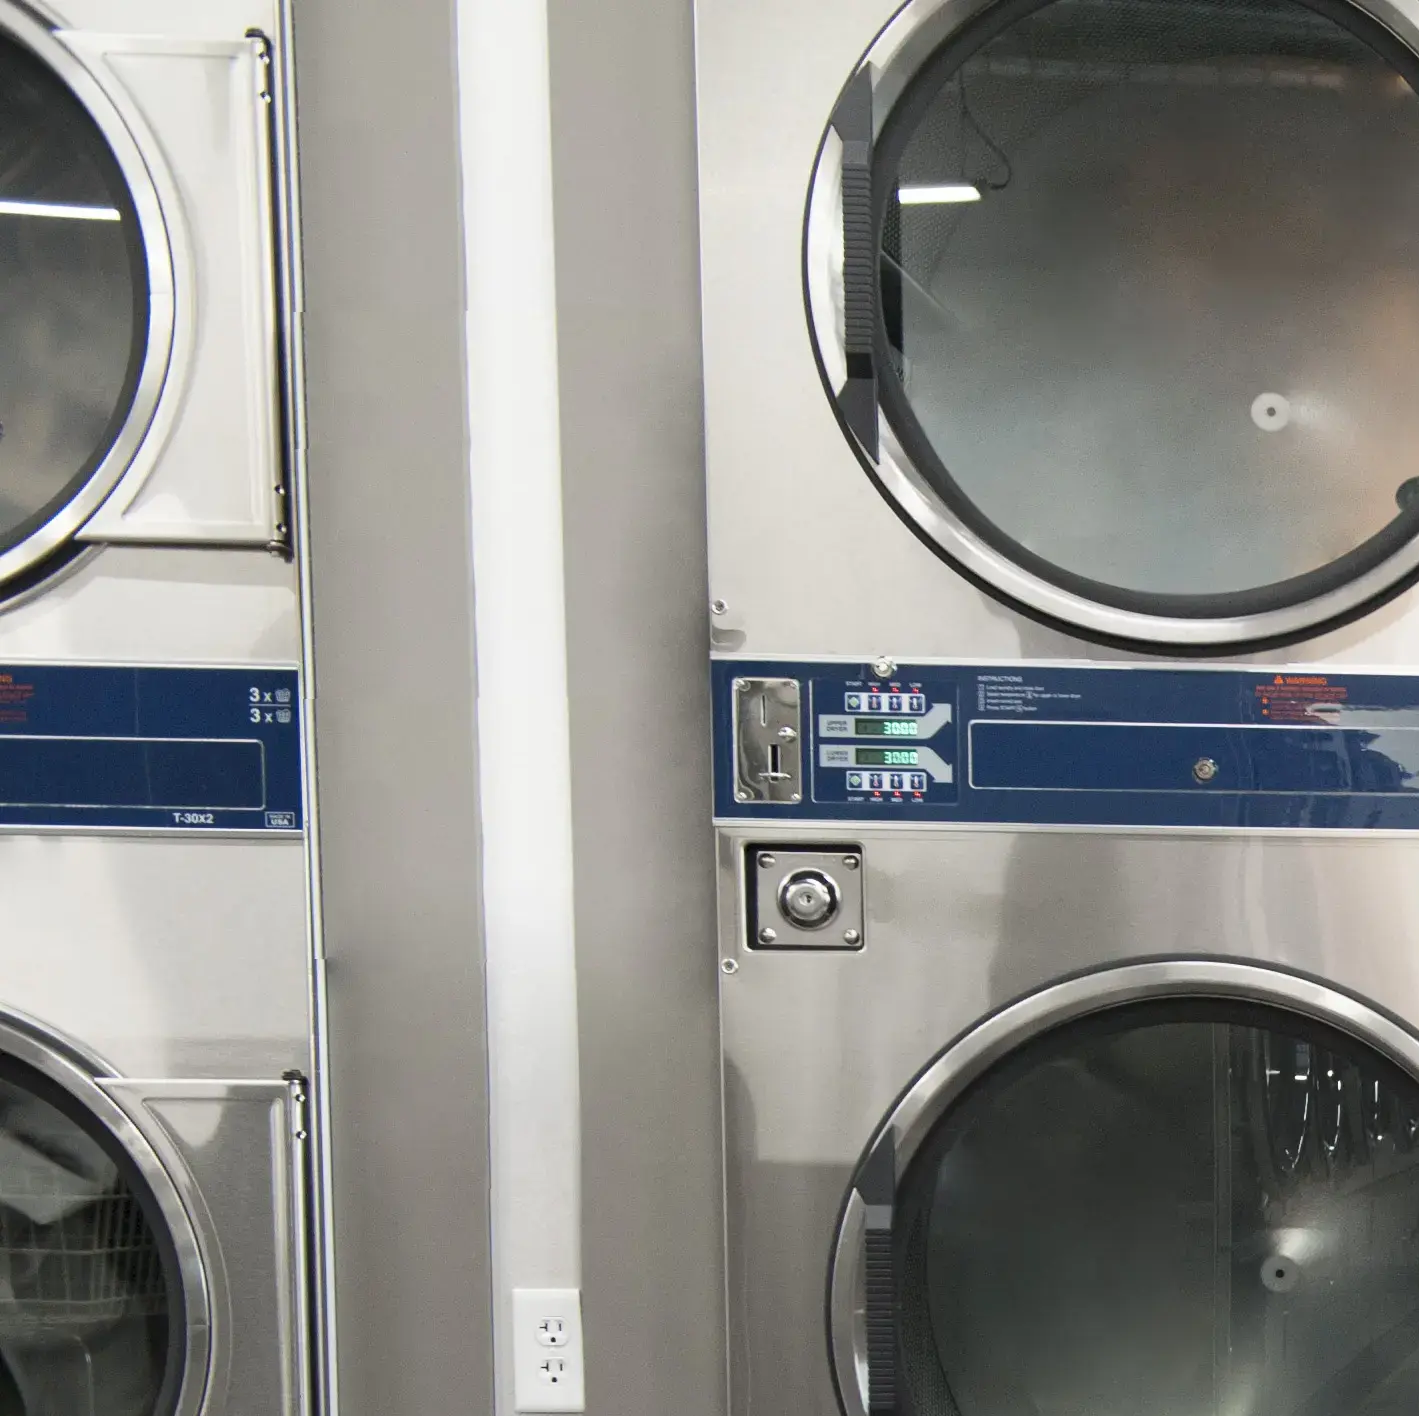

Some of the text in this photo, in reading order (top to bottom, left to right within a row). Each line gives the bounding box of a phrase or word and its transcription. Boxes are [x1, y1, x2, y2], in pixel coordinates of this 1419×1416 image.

[249, 687, 272, 702] 3 x
[250, 708, 273, 723] 3 x
[173, 812, 214, 824] T-30X2
